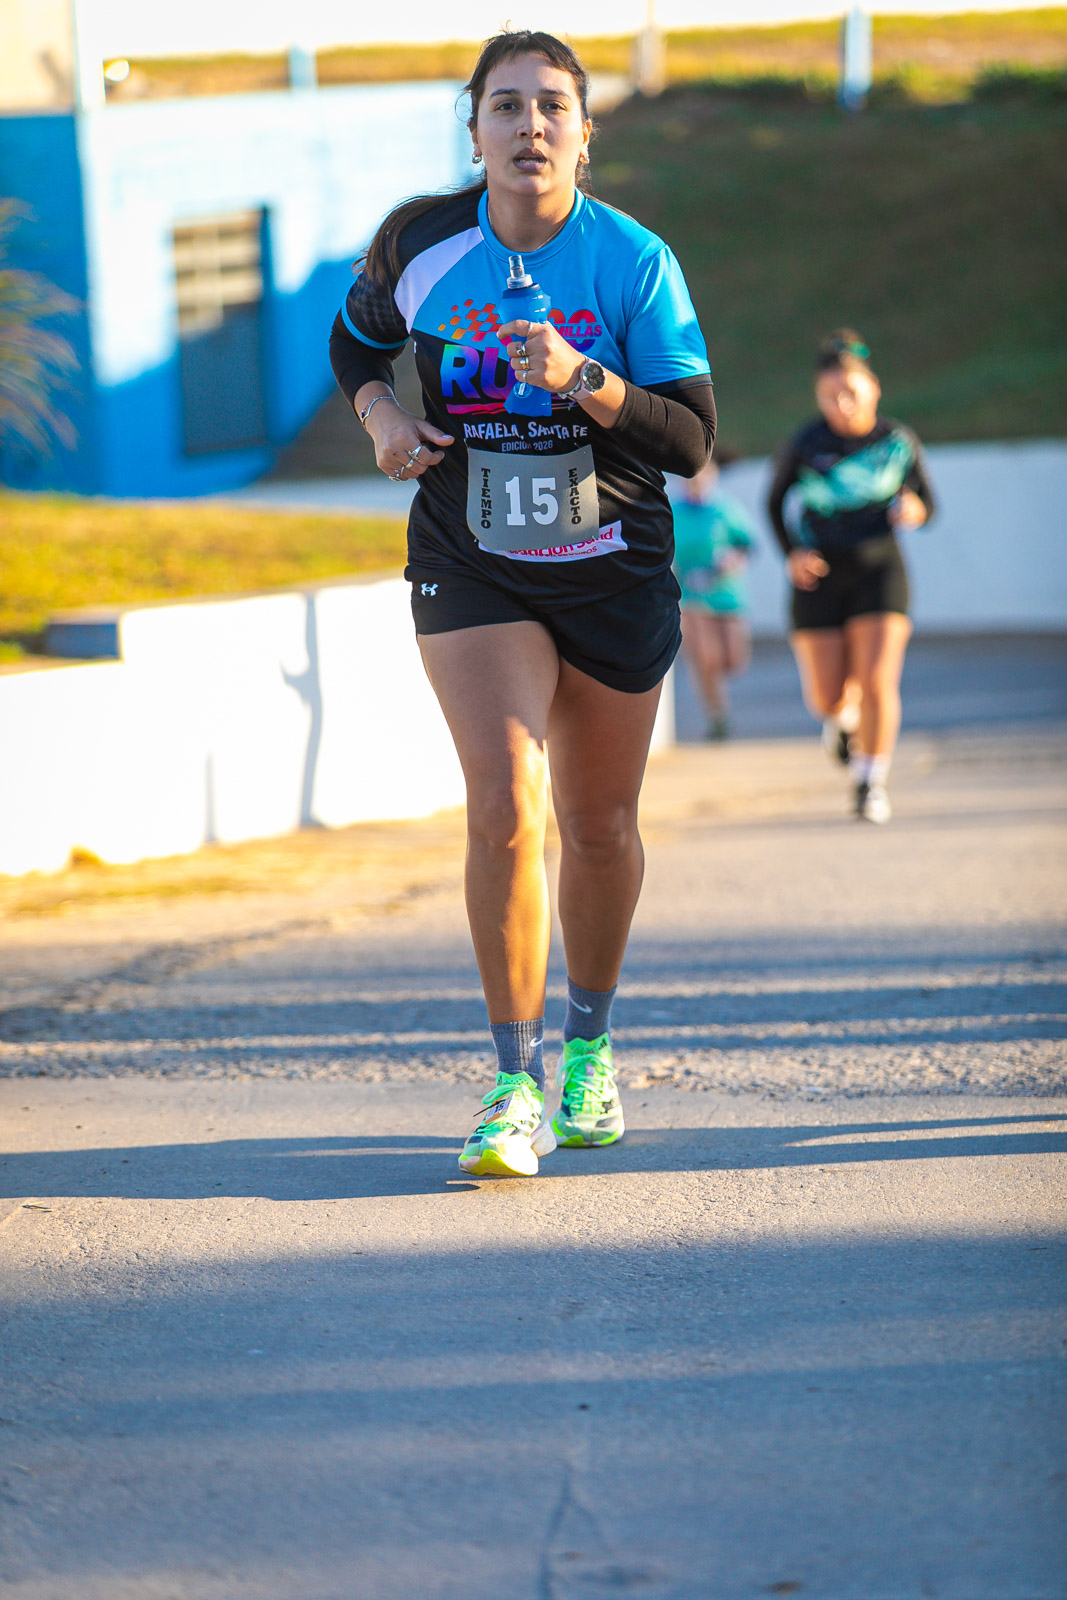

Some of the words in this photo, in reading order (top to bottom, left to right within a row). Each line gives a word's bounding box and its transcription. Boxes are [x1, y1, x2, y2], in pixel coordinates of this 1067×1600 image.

[463, 422, 524, 439] RAFAELA,
[573, 424, 588, 438] FE
[532, 440, 553, 452] 2026
[481, 468, 492, 529] TIEMPO
[505, 475, 559, 526] 15
[568, 468, 581, 525] EXACTO
